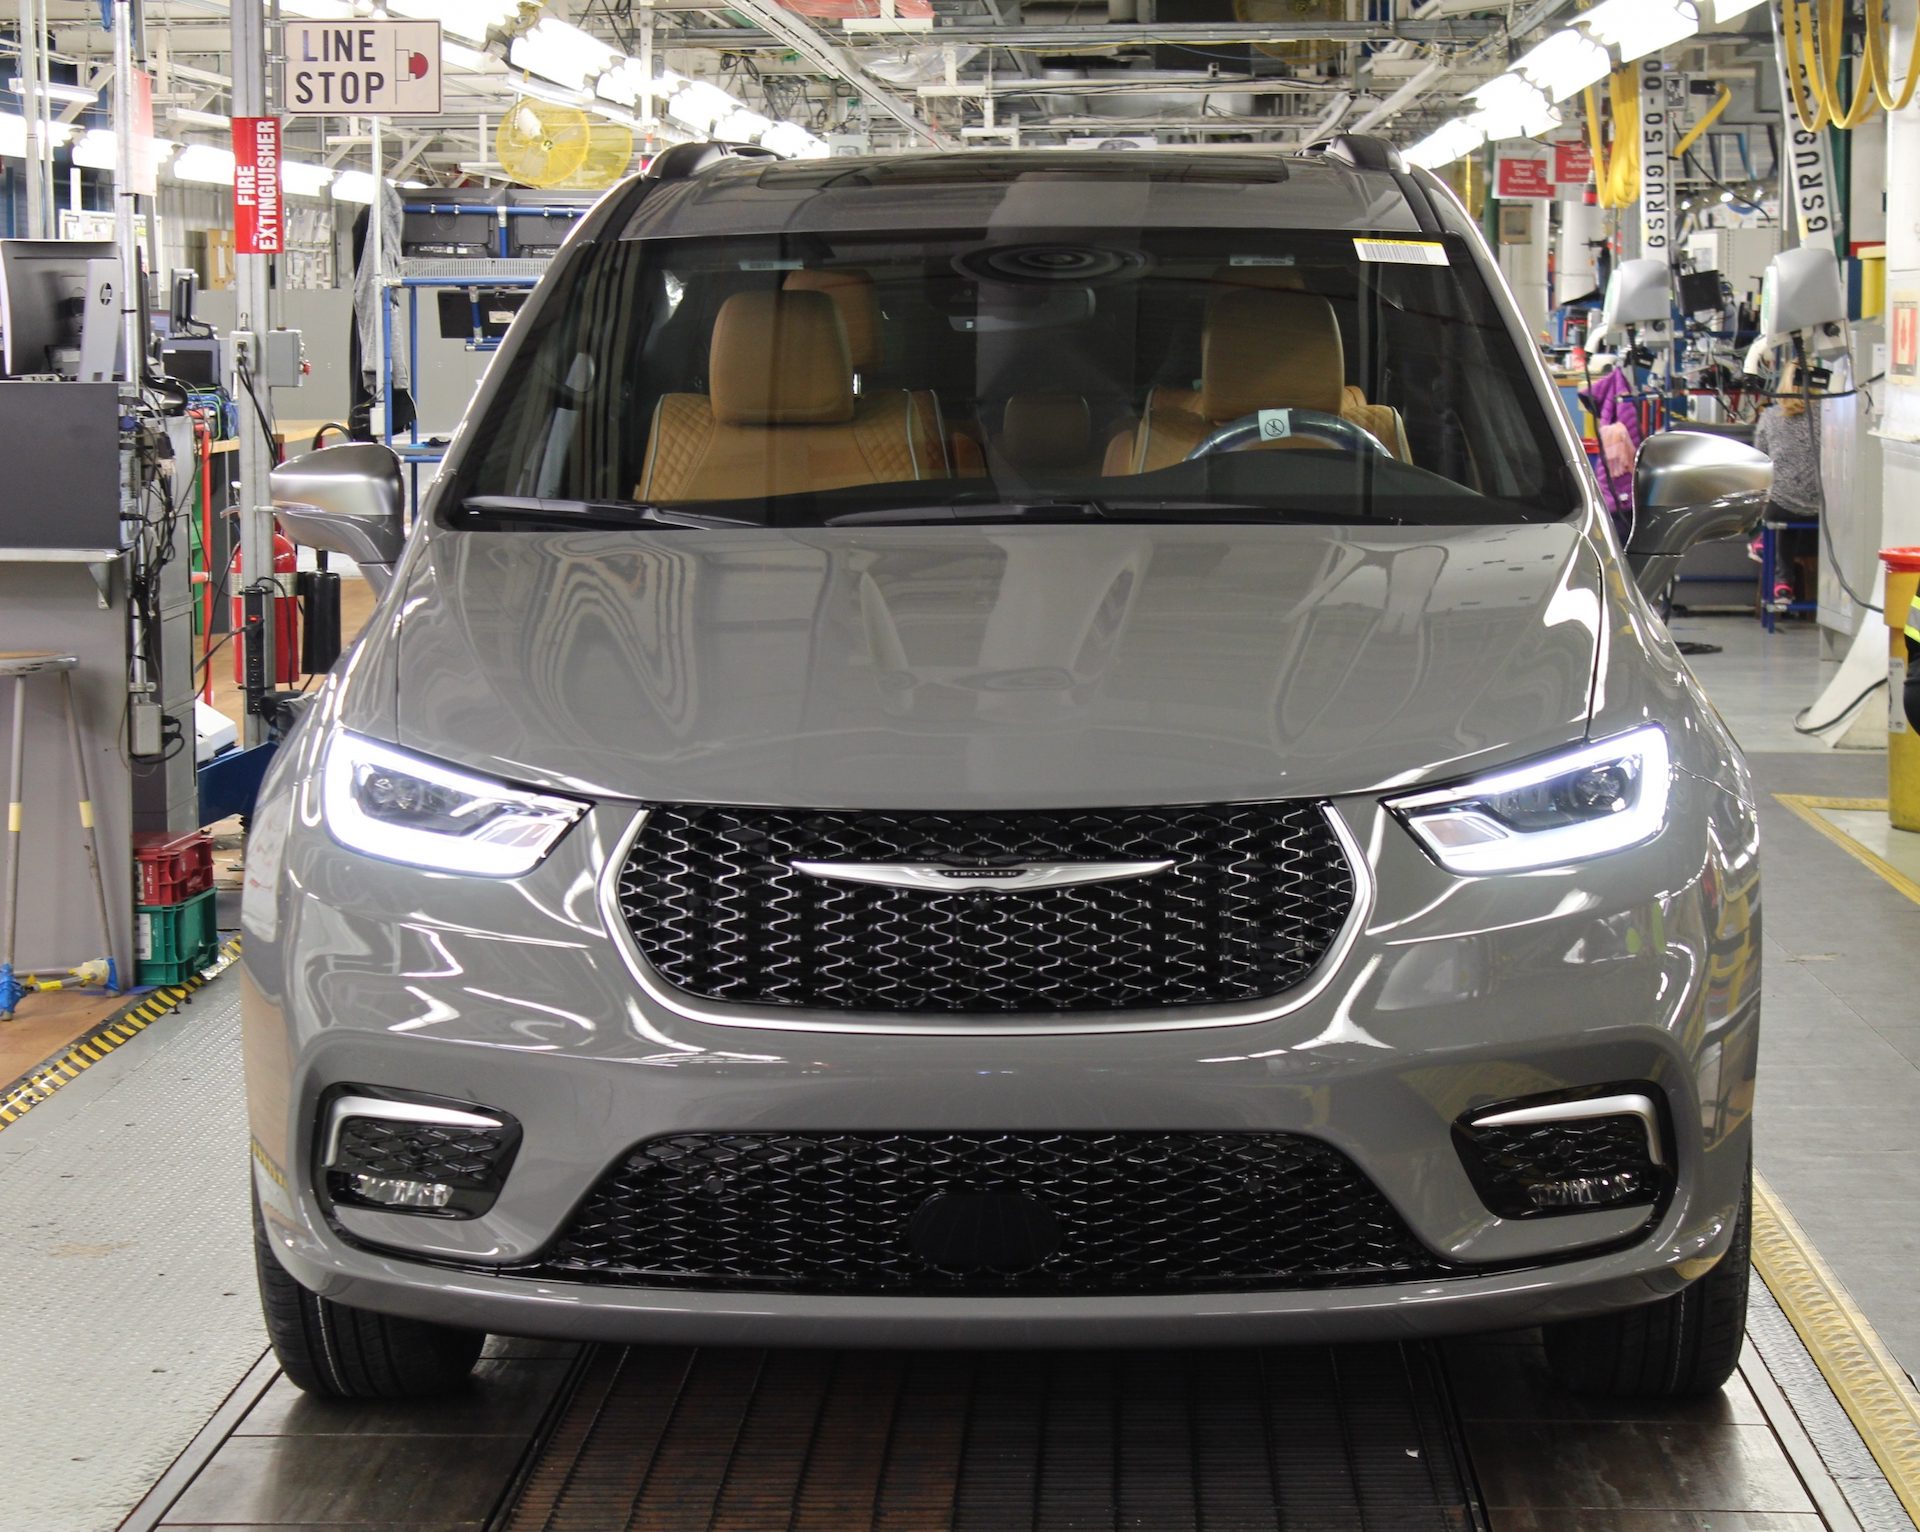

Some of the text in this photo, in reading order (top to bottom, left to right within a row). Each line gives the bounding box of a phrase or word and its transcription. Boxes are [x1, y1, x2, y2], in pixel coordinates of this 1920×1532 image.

[302, 29, 376, 62] LINE
[295, 71, 385, 104] STOP
[1643, 50, 1666, 249] GSRU9150-00
[237, 165, 256, 206] FIRE
[256, 120, 278, 251] EXTINGUISHER
